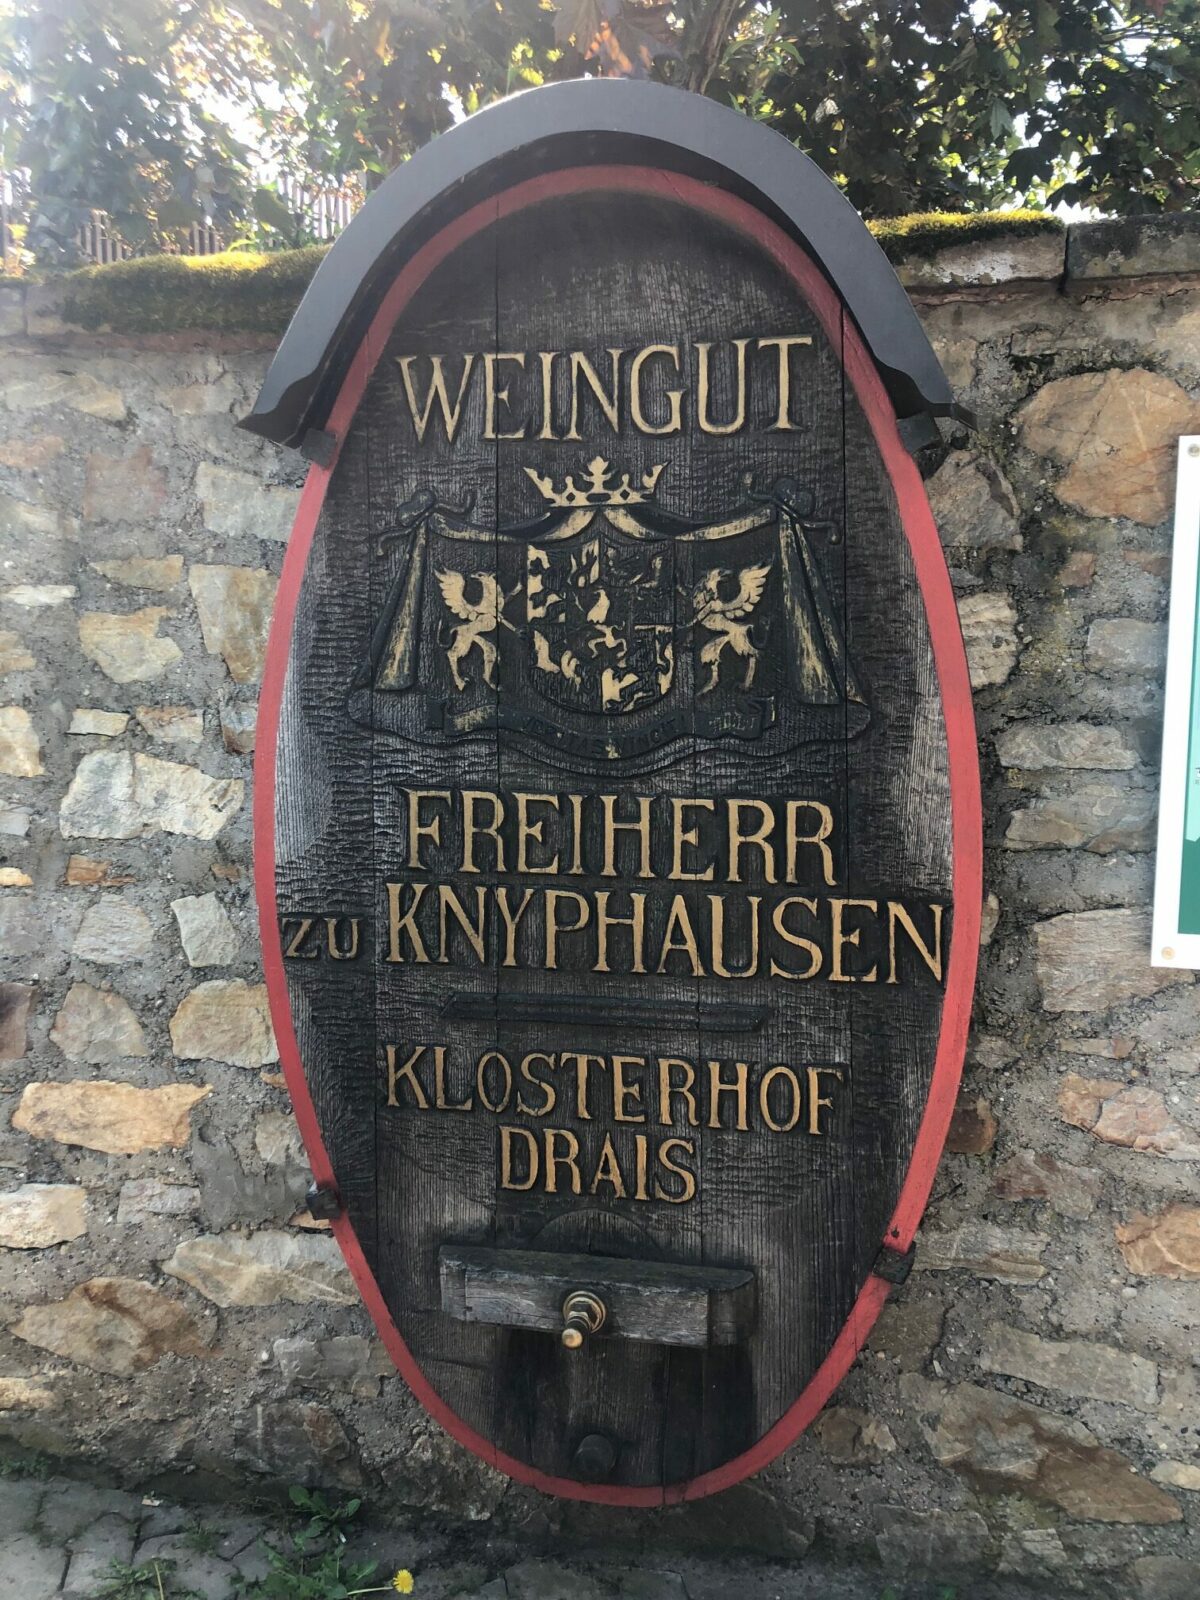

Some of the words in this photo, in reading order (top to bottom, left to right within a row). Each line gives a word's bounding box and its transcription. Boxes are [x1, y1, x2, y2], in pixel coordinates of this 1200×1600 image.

[395, 336, 813, 443] WEINGUT
[406, 789, 836, 885] FREIHERR
[283, 915, 361, 960] ZU
[386, 882, 948, 985] KNYPHAUSEN
[385, 1043, 845, 1136] KLOSTERHOF
[499, 1126, 697, 1204] DRAIS
